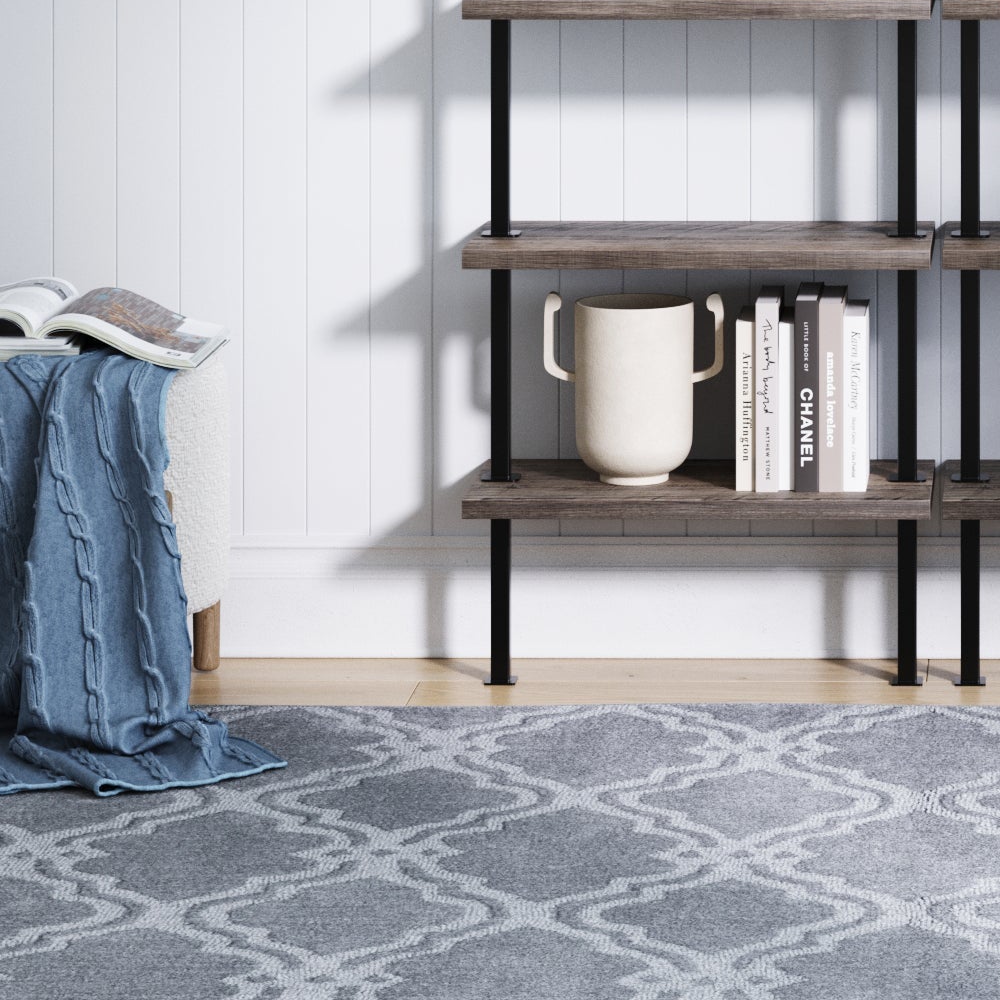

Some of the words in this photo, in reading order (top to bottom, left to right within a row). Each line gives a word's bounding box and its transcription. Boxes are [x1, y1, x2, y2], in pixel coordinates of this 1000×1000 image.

[762, 319, 773, 342] The
[850, 331, 861, 358] Karen
[742, 352, 752, 395] Arianna
[762, 346, 775, 371] body
[803, 363, 809, 372] OF
[826, 352, 836, 397] amanda
[757, 376, 774, 414] beyond
[848, 360, 861, 410] McCartney
[740, 401, 753, 461] Huffington
[800, 388, 813, 467] CHANEL
[826, 400, 836, 448] lovelace
